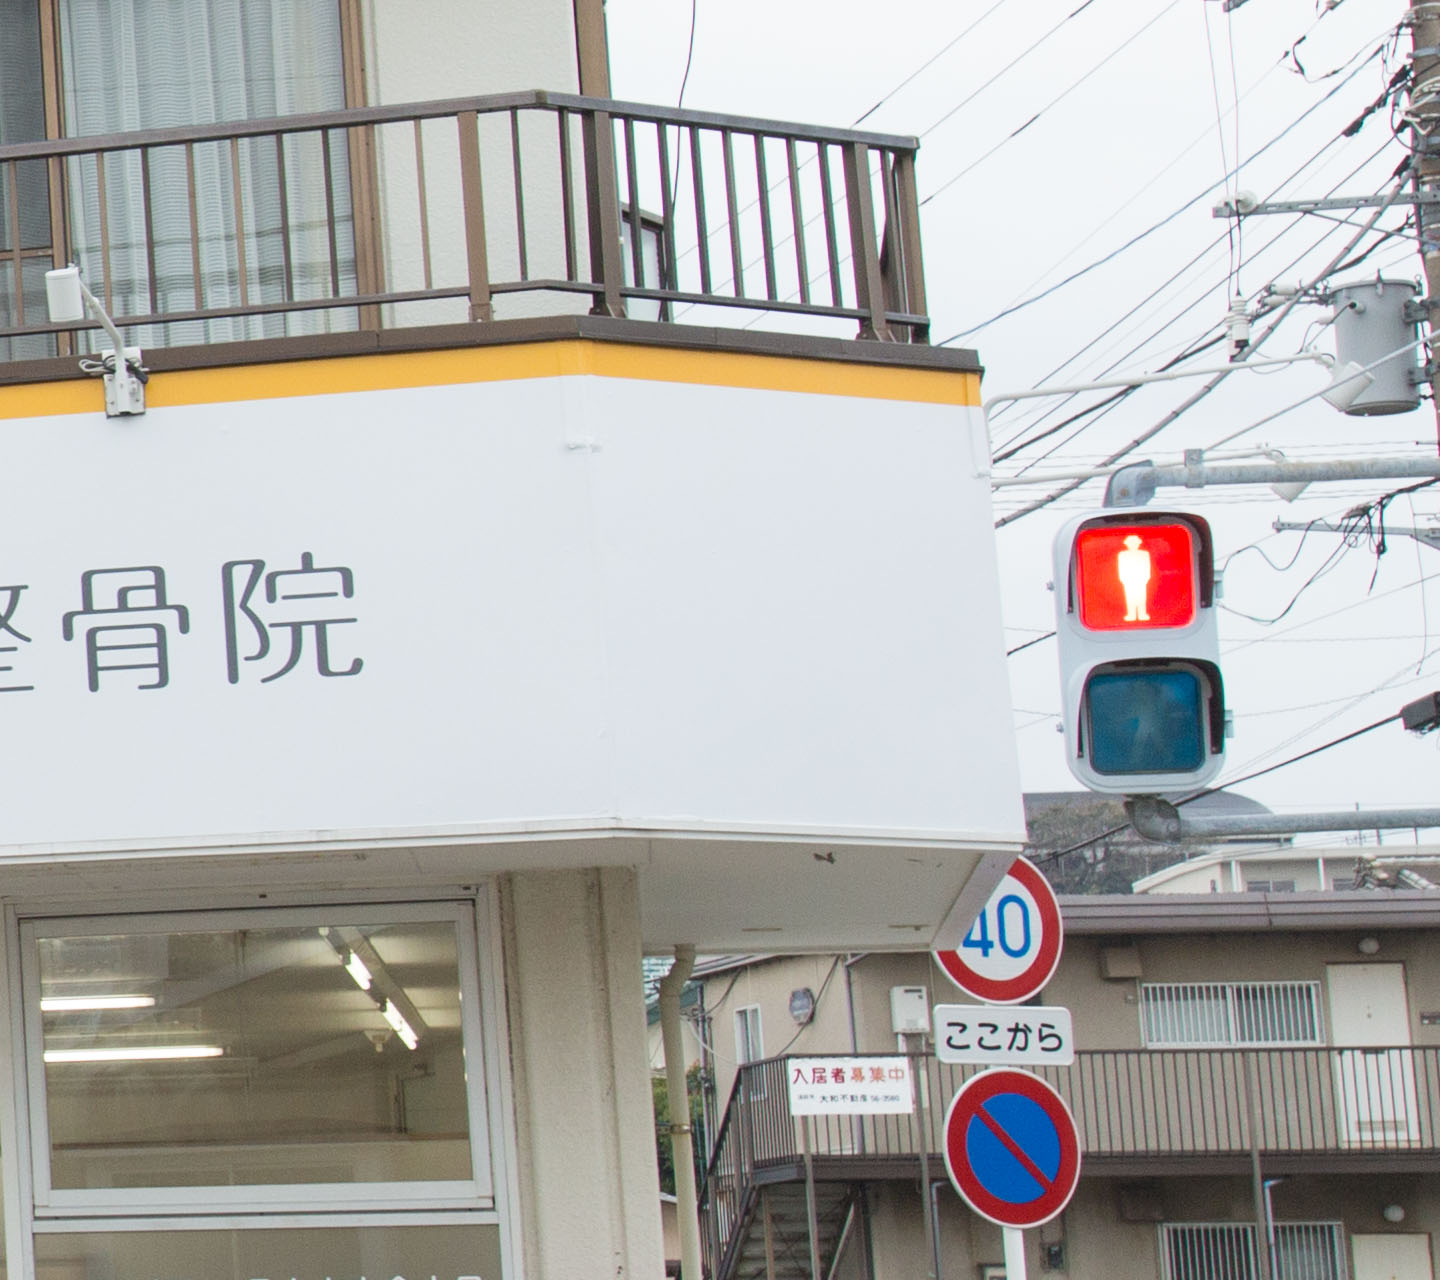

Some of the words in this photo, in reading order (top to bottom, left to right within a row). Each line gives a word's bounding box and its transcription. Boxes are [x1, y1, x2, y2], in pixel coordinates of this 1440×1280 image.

[962, 894, 1031, 959] 40
[945, 1021, 1063, 1053] ここから
[793, 1066, 905, 1085] 入居者募集中
